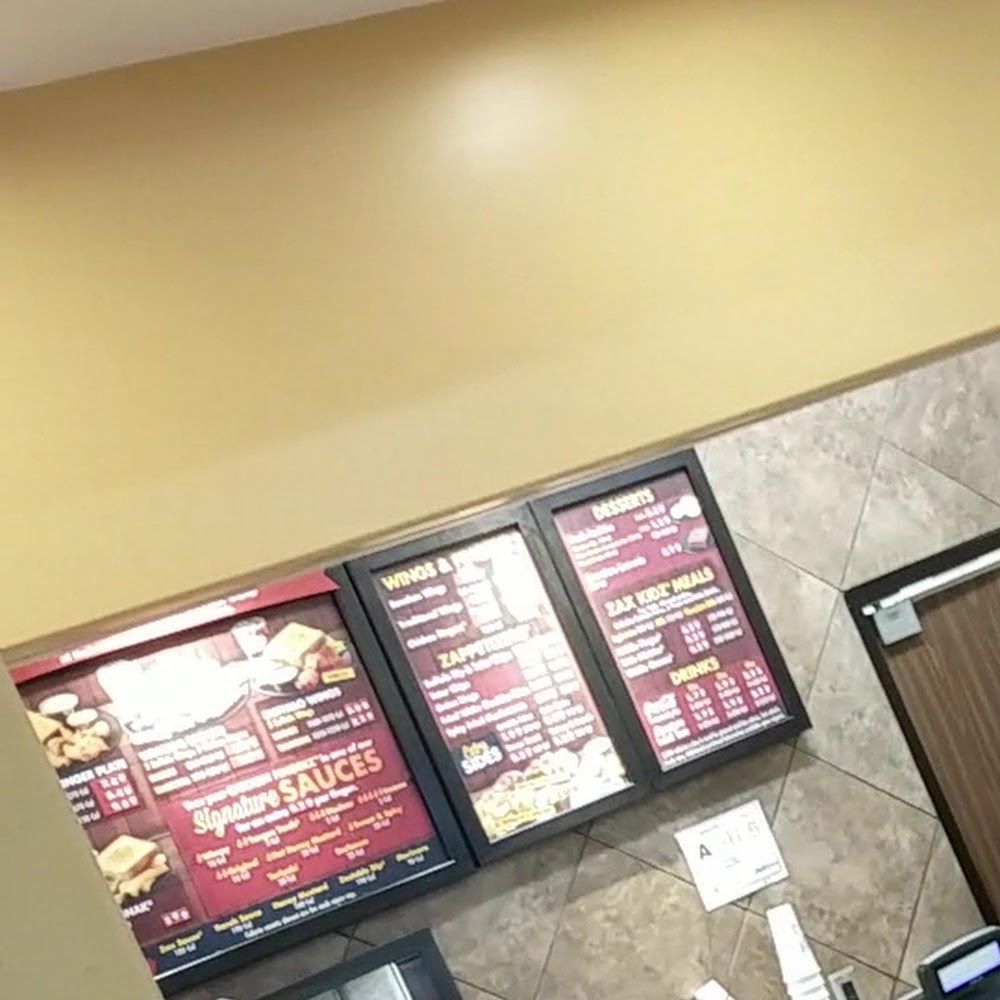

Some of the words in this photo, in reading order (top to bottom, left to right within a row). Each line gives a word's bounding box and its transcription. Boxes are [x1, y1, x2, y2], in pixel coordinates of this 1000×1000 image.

[381, 562, 437, 591] WINGS
[604, 594, 635, 617] ZAX
[669, 656, 720, 686] DRINKS
[193, 789, 279, 837] Signature
[279, 749, 383, 803] SAUCES
